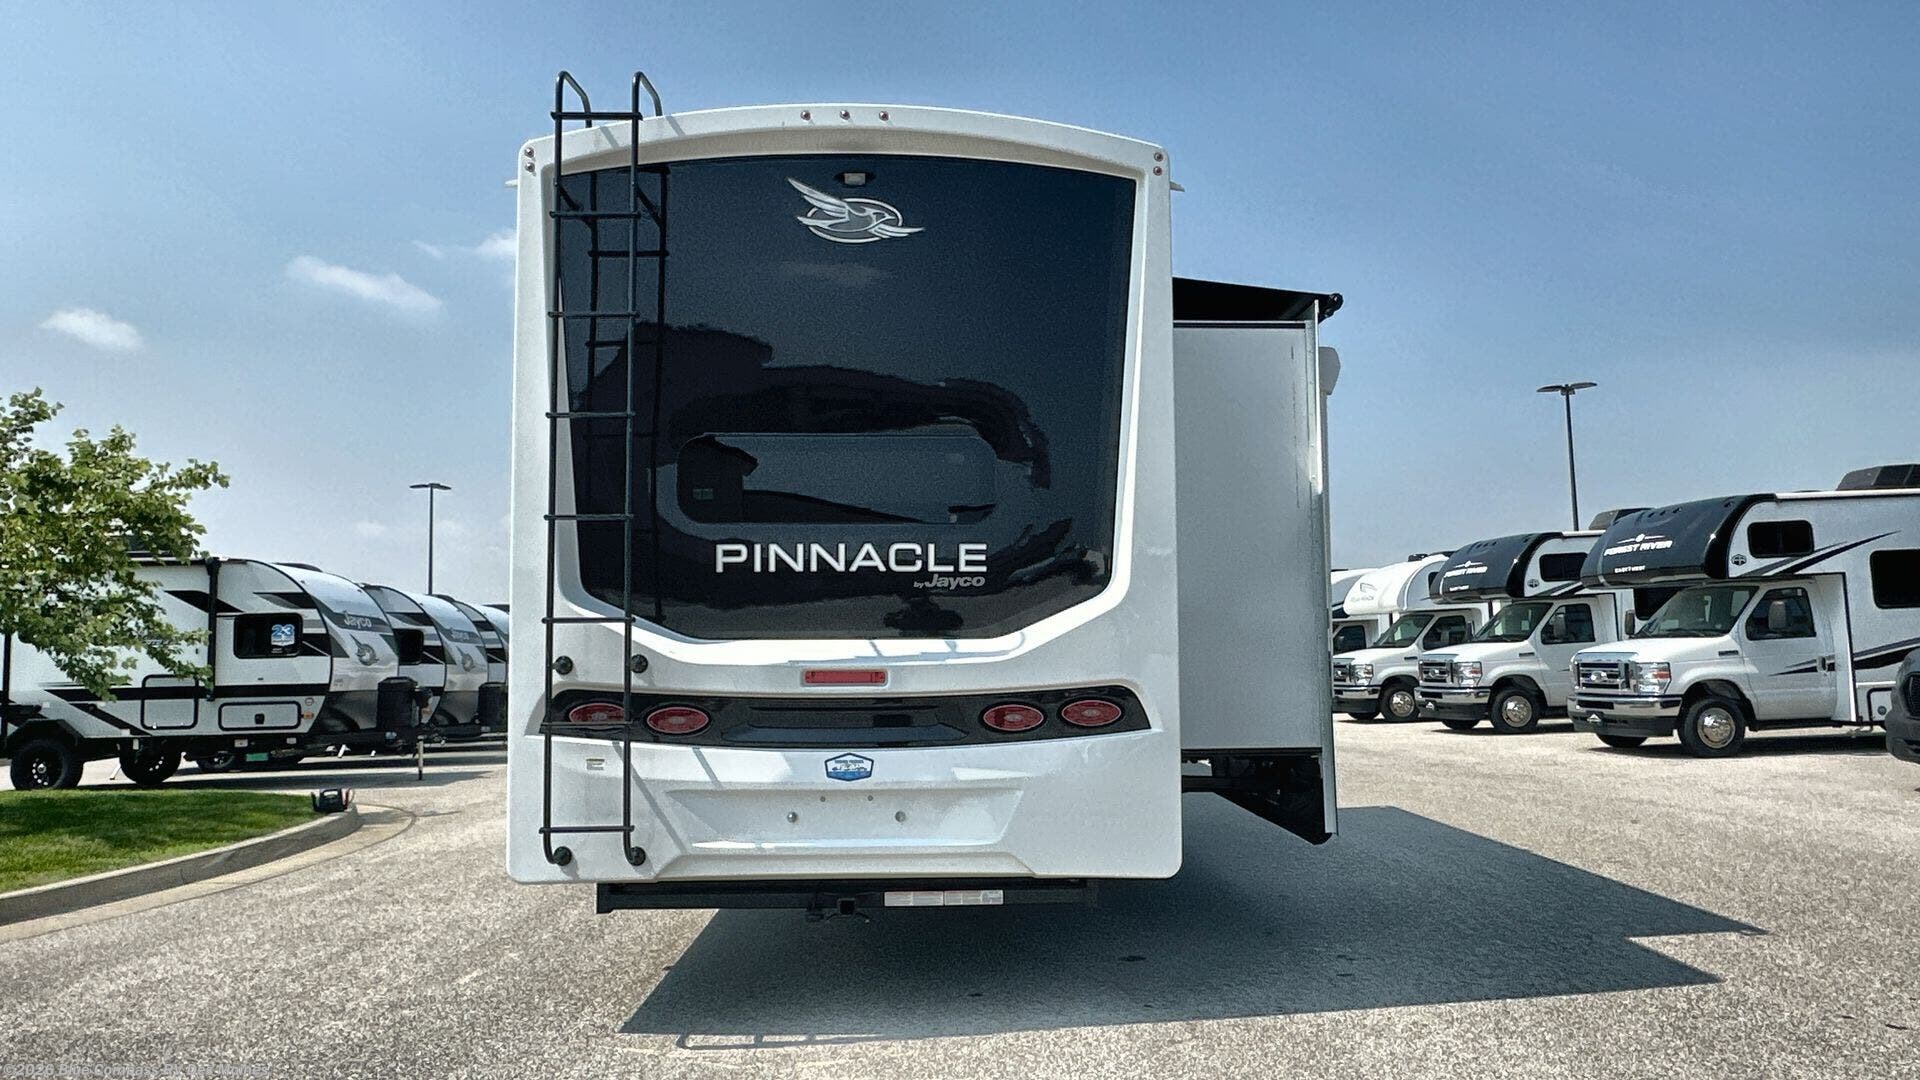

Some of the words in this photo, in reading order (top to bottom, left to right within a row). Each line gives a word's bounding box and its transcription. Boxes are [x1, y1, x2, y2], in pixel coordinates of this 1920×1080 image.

[1603, 544, 1640, 556] FOREST
[1640, 540, 1673, 551] RIVER
[715, 543, 988, 573] PINNACLE
[913, 581, 924, 589] by
[924, 573, 986, 590] Jayco
[343, 610, 372, 629] Jayco
